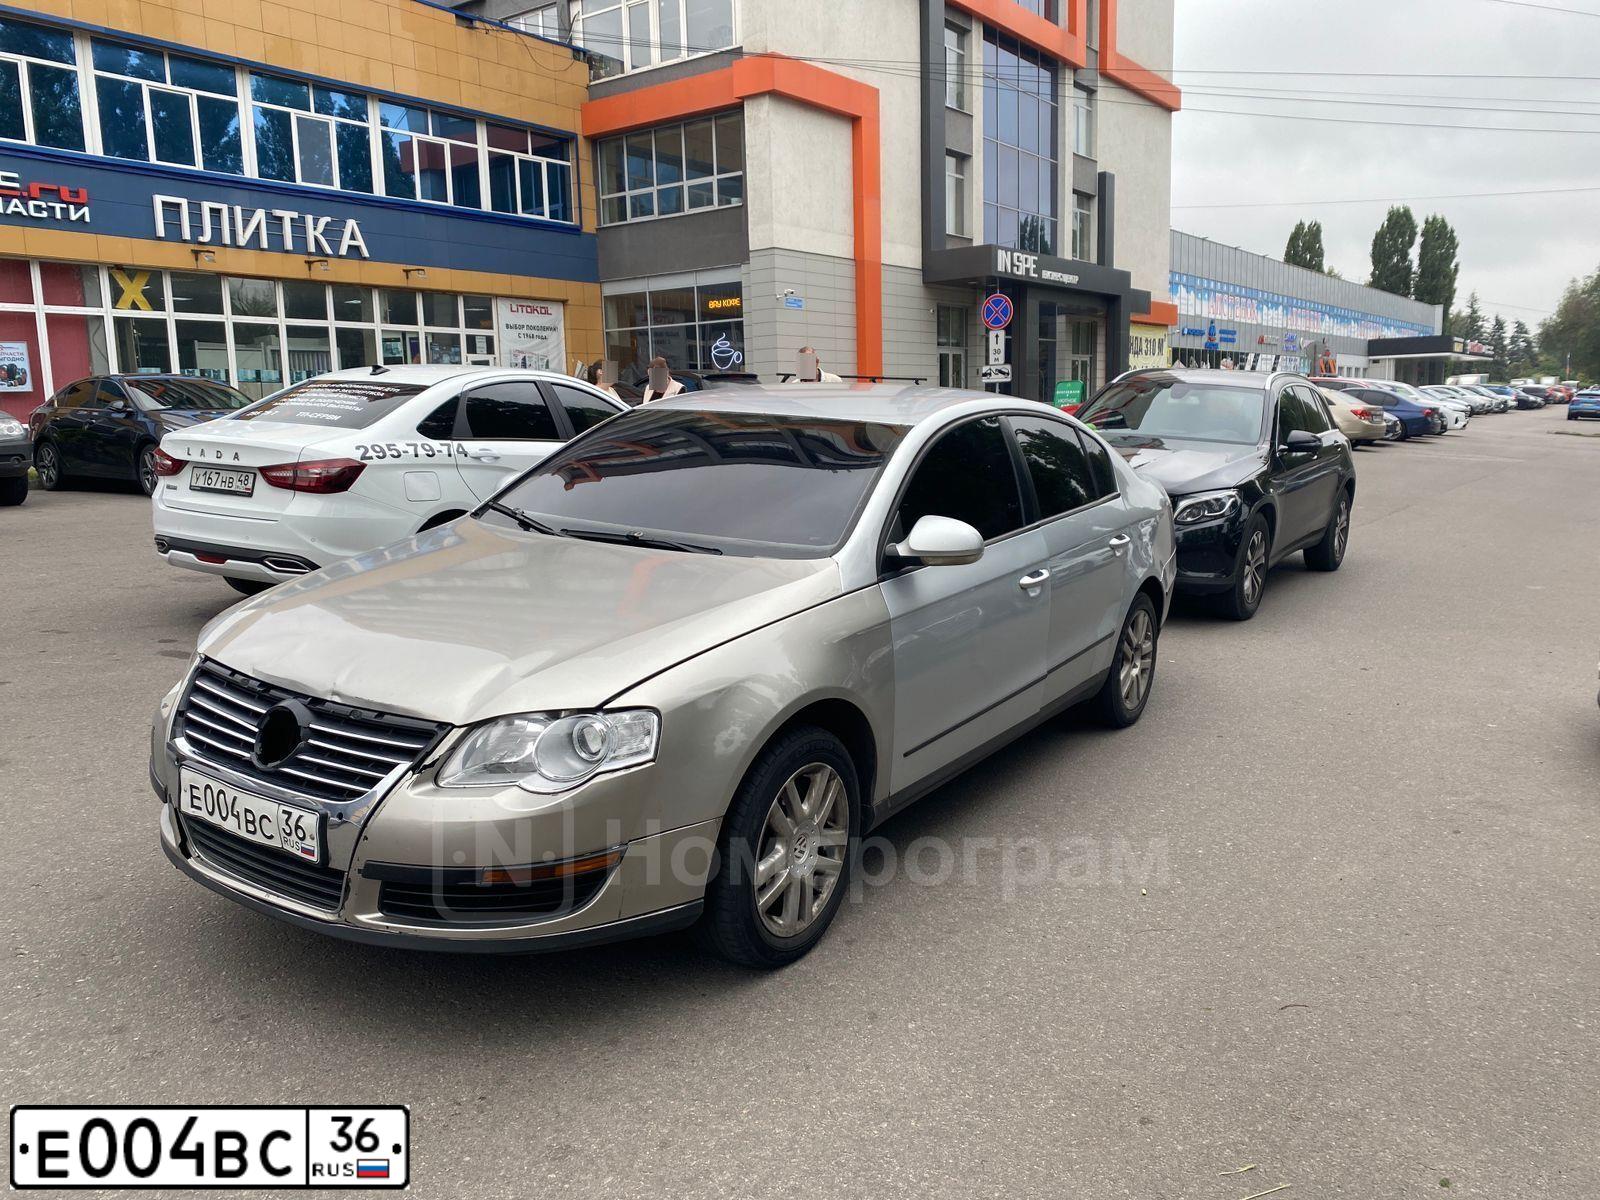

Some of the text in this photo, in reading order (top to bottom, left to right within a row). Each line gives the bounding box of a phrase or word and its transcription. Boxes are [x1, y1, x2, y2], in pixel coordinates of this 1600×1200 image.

[0, 197, 91, 223] АСТИ
[152, 194, 370, 258] ПЛИТКА
[997, 249, 1038, 278] IN SPE
[509, 303, 552, 316] LITOKOL
[505, 323, 525, 331] ВЫБОР
[1144, 337, 1157, 356] 310
[186, 447, 240, 462] LADA
[355, 443, 468, 461] 295-79-74
[195, 470, 250, 488] У167НВ 48
[189, 783, 307, 842] Е004ВС 36
[283, 836, 300, 851] RUS
